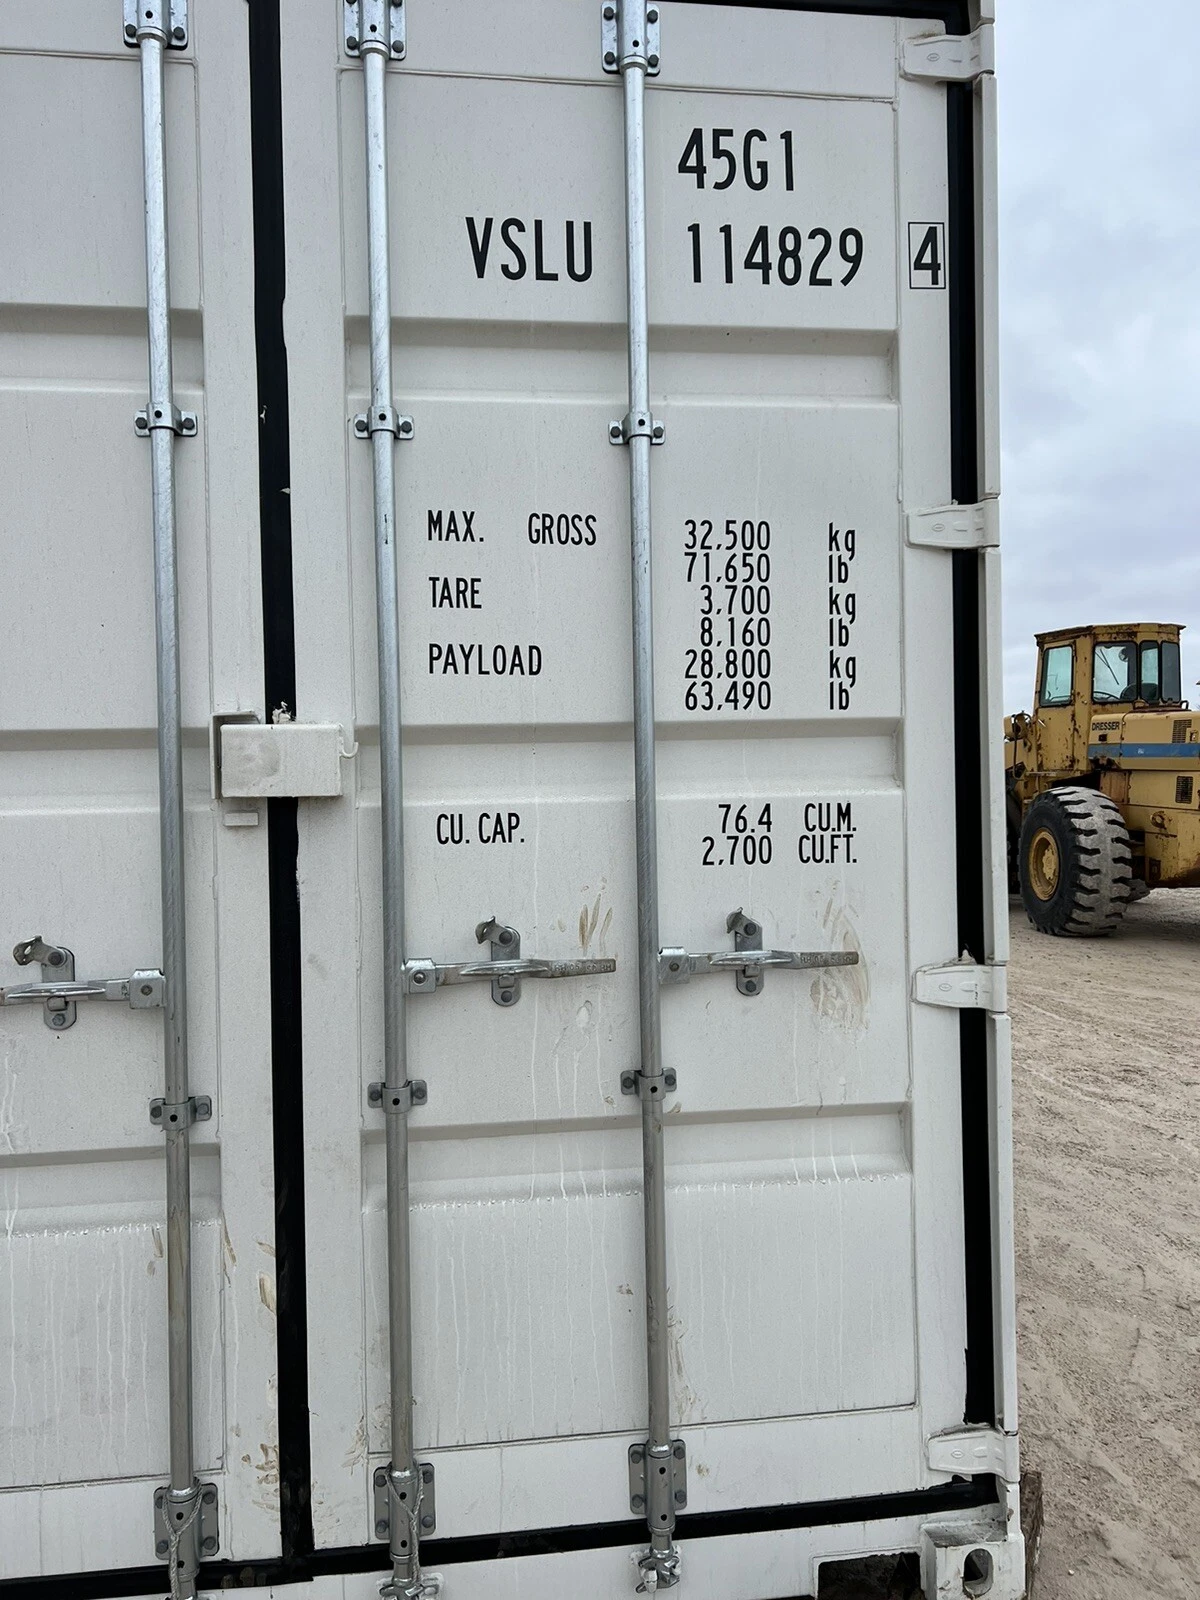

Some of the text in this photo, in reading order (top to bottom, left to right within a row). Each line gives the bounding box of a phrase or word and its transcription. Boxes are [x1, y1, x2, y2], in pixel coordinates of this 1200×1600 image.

[678, 128, 794, 191] 45G1
[466, 217, 942, 287] VSLU 114829 4
[428, 510, 856, 562] MAX. GROSS 32,500 kg
[685, 552, 849, 584] 71,650 lb
[429, 577, 856, 625] TARE 3,700 kg
[701, 617, 850, 647] 8,160 lb
[430, 644, 856, 688] PAYLOAD 28,800 kg
[685, 681, 850, 711] 63,490 lb
[1092, 721, 1120, 731] DRESSER
[479, 812, 525, 844] CAP.
[719, 803, 773, 834] 76.4
[805, 803, 857, 833] CU.M.
[703, 834, 857, 866] 2,700 CU.FT.
